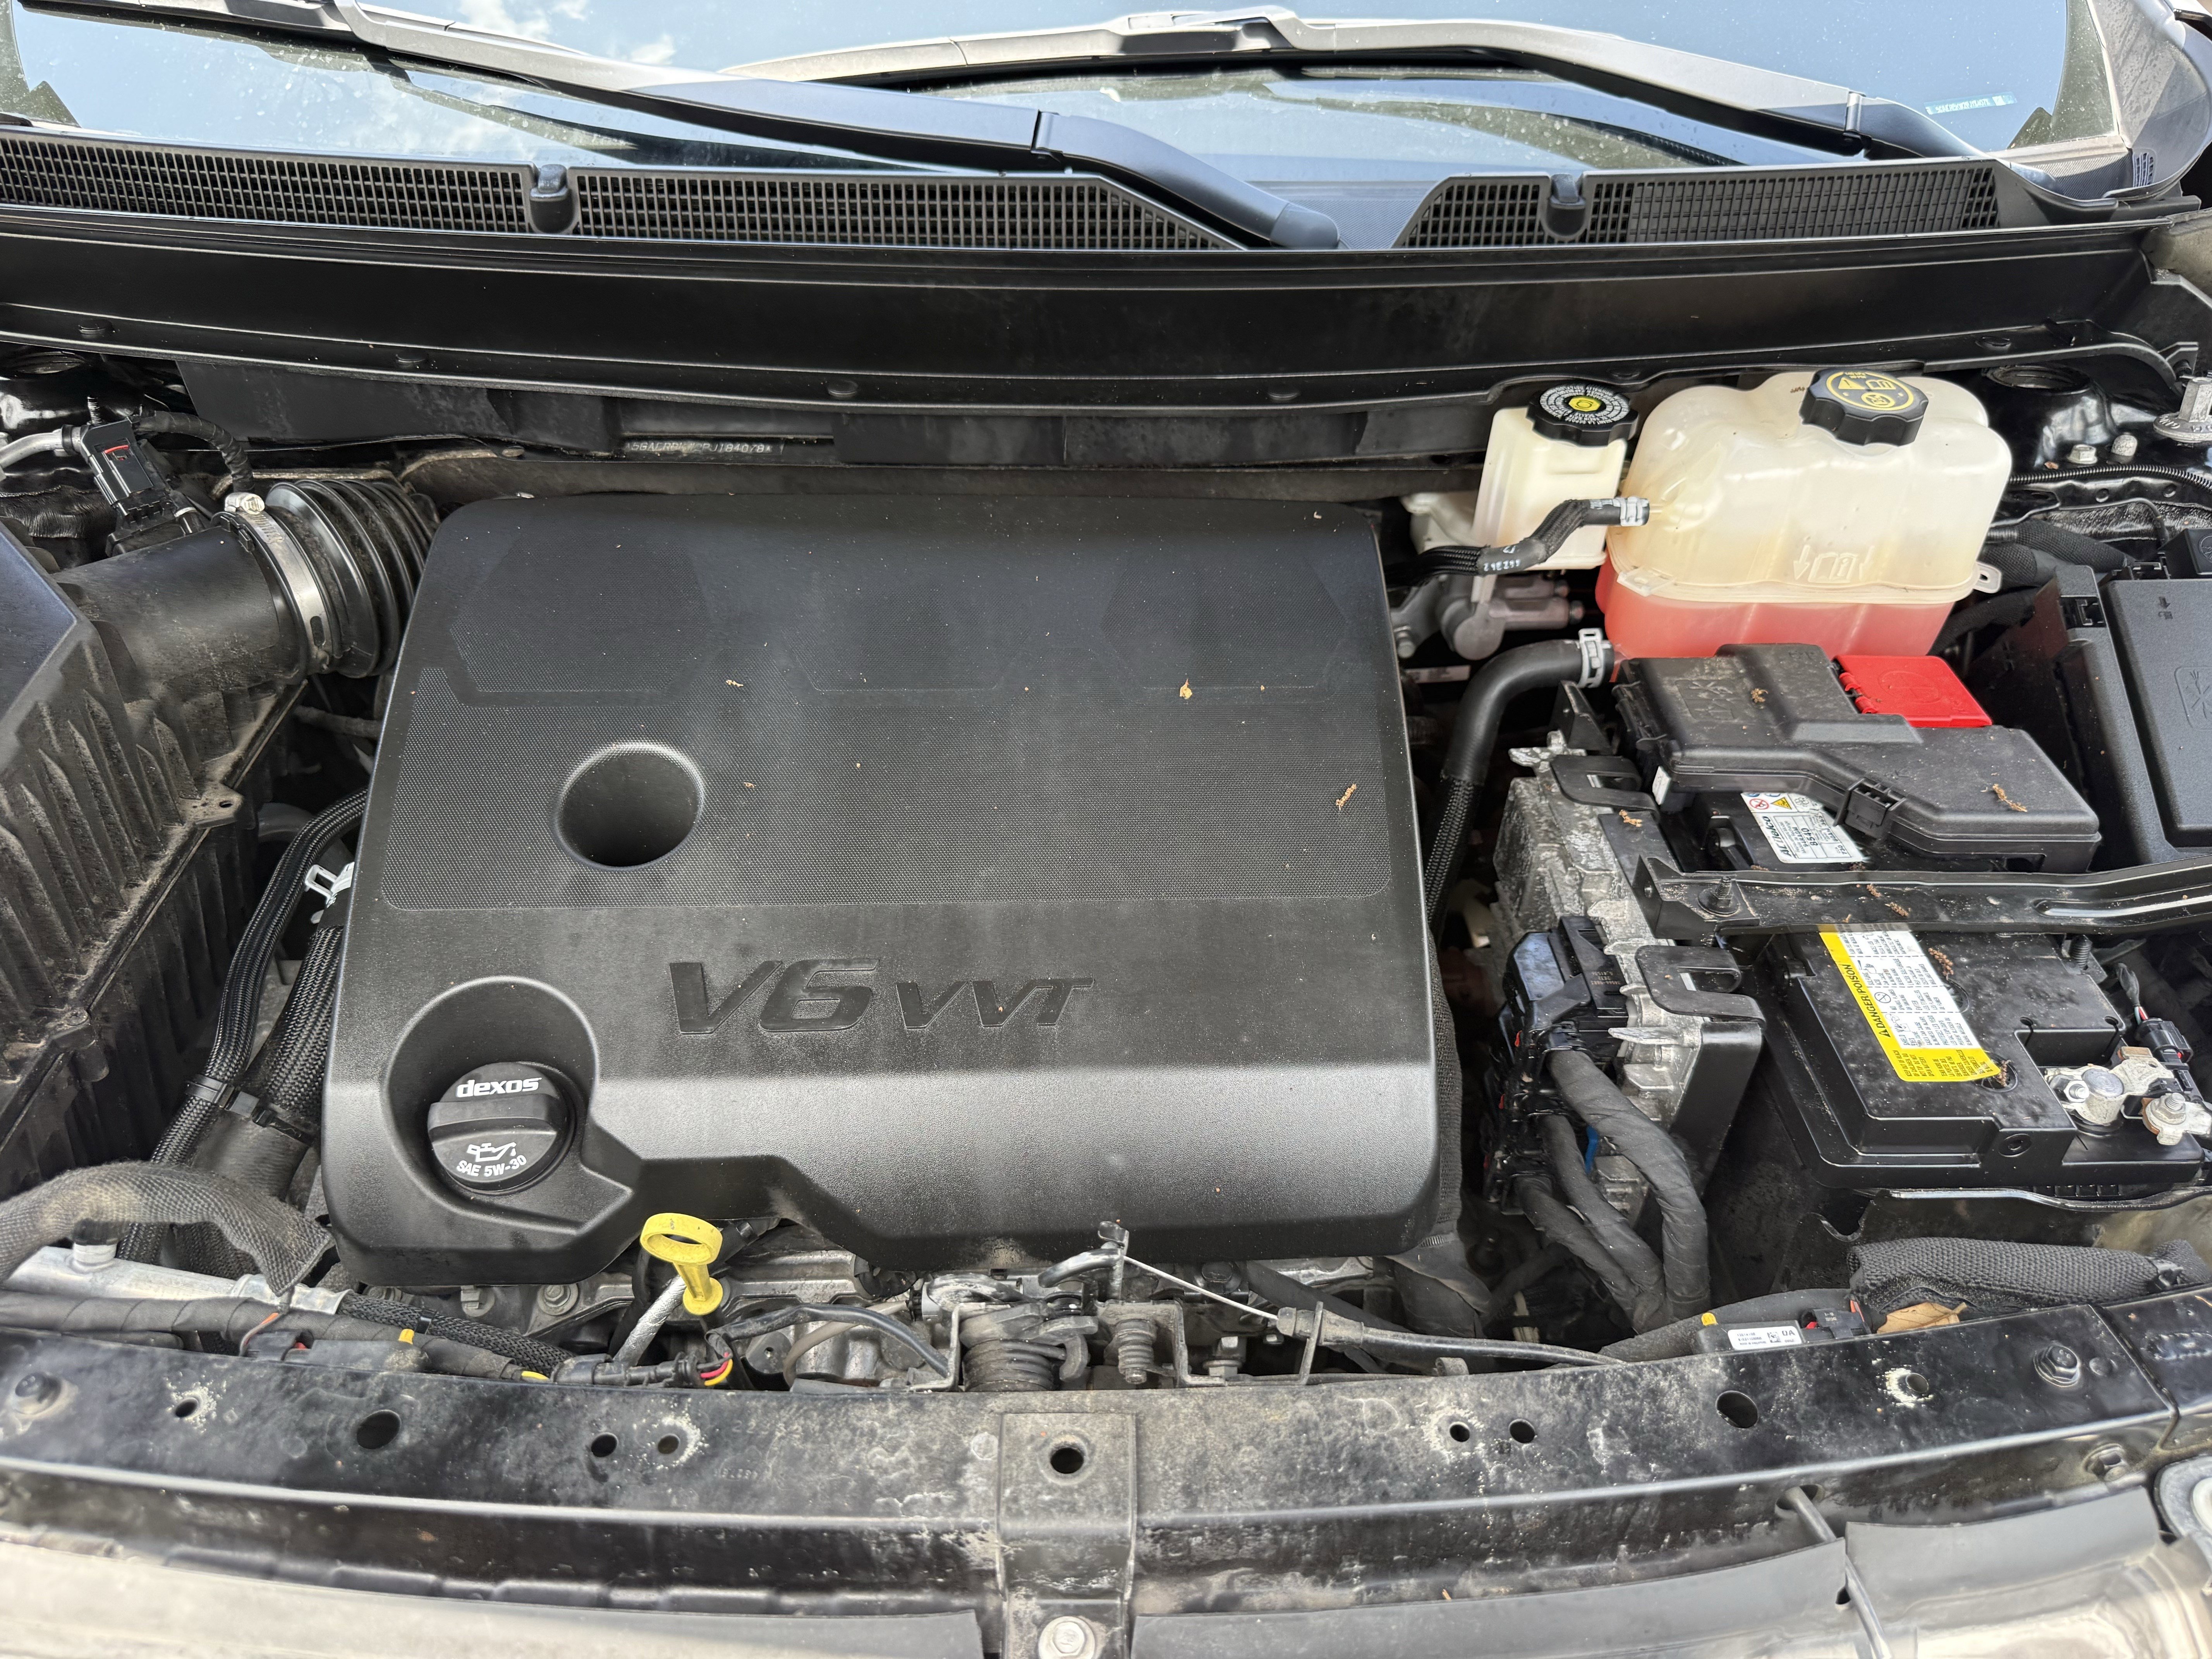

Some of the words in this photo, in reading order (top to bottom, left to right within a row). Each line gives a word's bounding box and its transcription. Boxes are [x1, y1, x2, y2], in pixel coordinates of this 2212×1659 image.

[1761, 816, 1792, 857] ACDelco
[1801, 828, 1818, 846] 8540
[1838, 845, 1847, 854] 730
[669, 958, 879, 1036] V6
[896, 978, 1095, 1030] VVT
[1841, 964, 1887, 1028] DANGER/POISON
[456, 1077, 542, 1097] dexos
[457, 1160, 481, 1177] SAE
[484, 1155, 527, 1177] 5W-30
